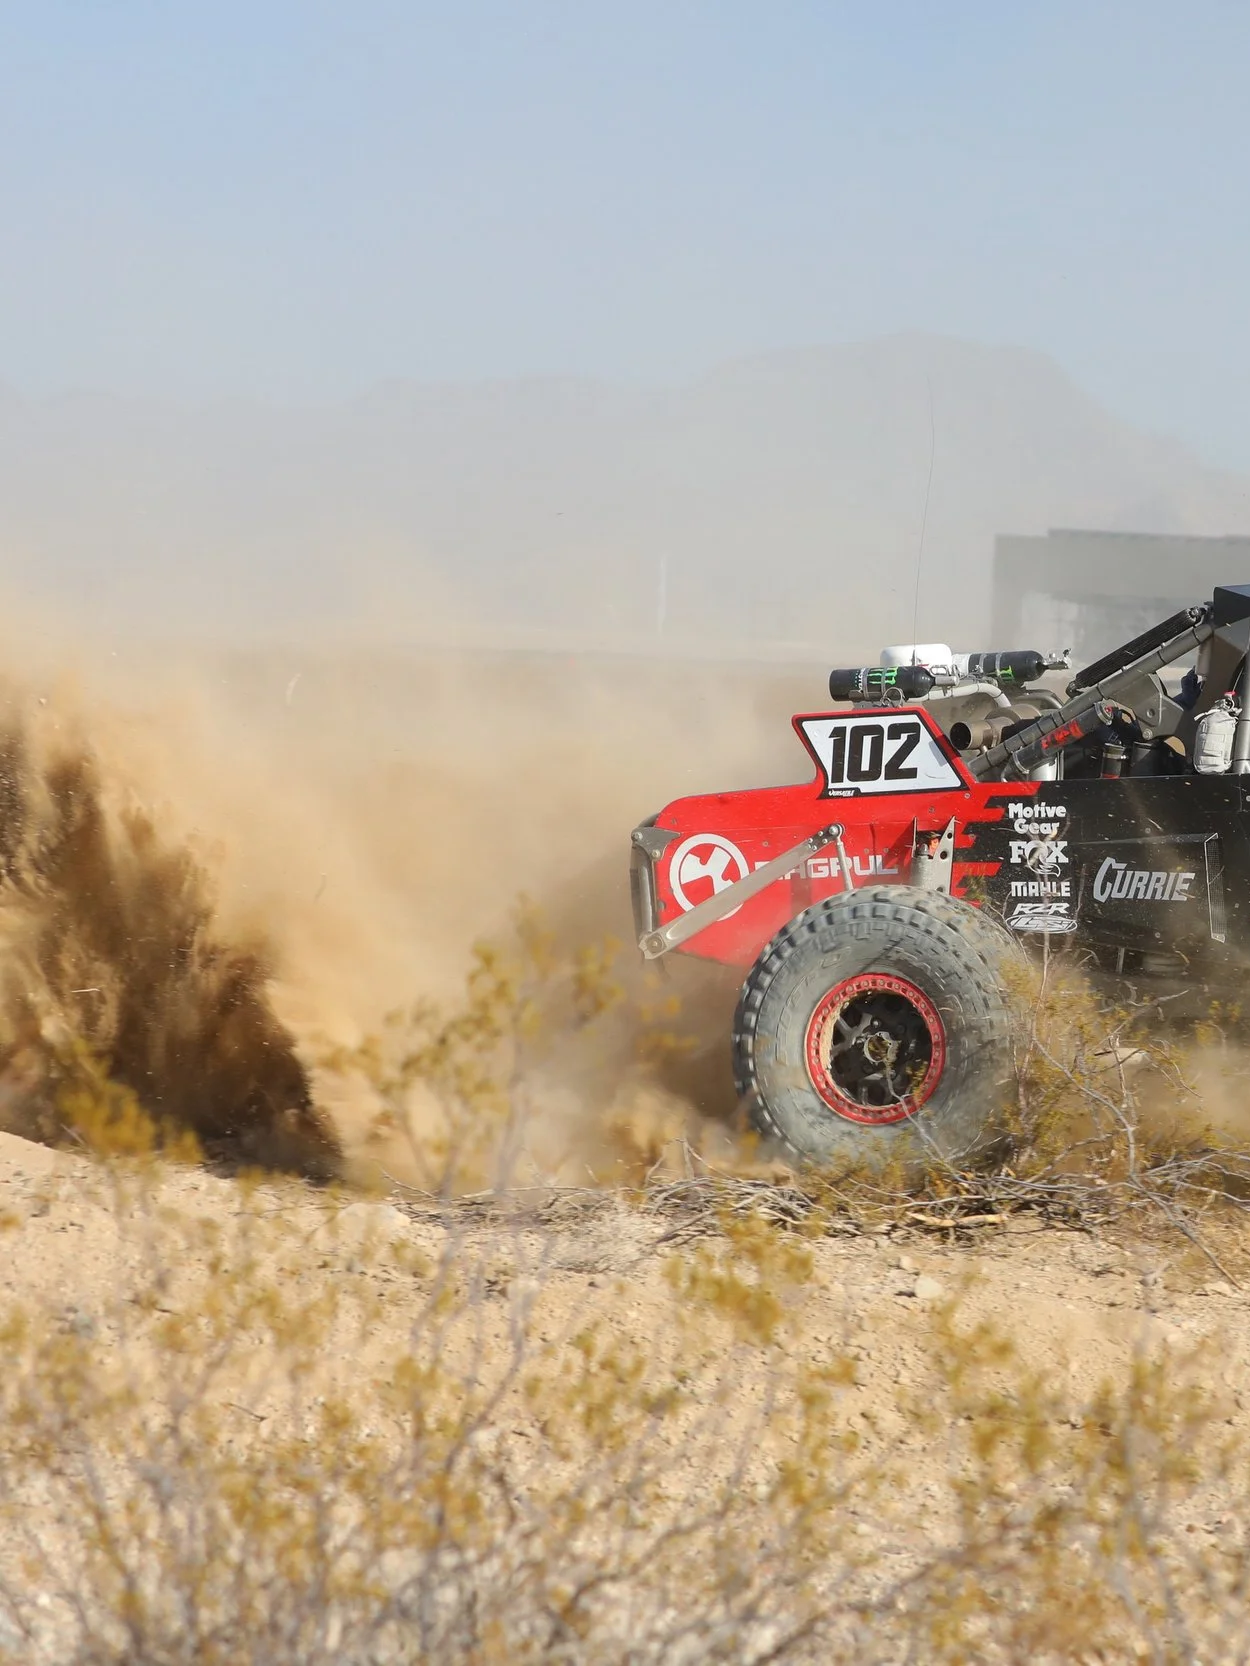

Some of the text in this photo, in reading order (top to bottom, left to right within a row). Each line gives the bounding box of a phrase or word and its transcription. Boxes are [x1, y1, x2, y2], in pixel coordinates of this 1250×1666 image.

[829, 722, 921, 784] 102
[1008, 802, 1067, 818] Motive
[1014, 818, 1060, 835] Gear
[1008, 840, 1069, 872] FOX
[1093, 856, 1195, 903] CURRIE
[1011, 881, 1071, 897] MAHLE
[1013, 902, 1070, 916] RZR
